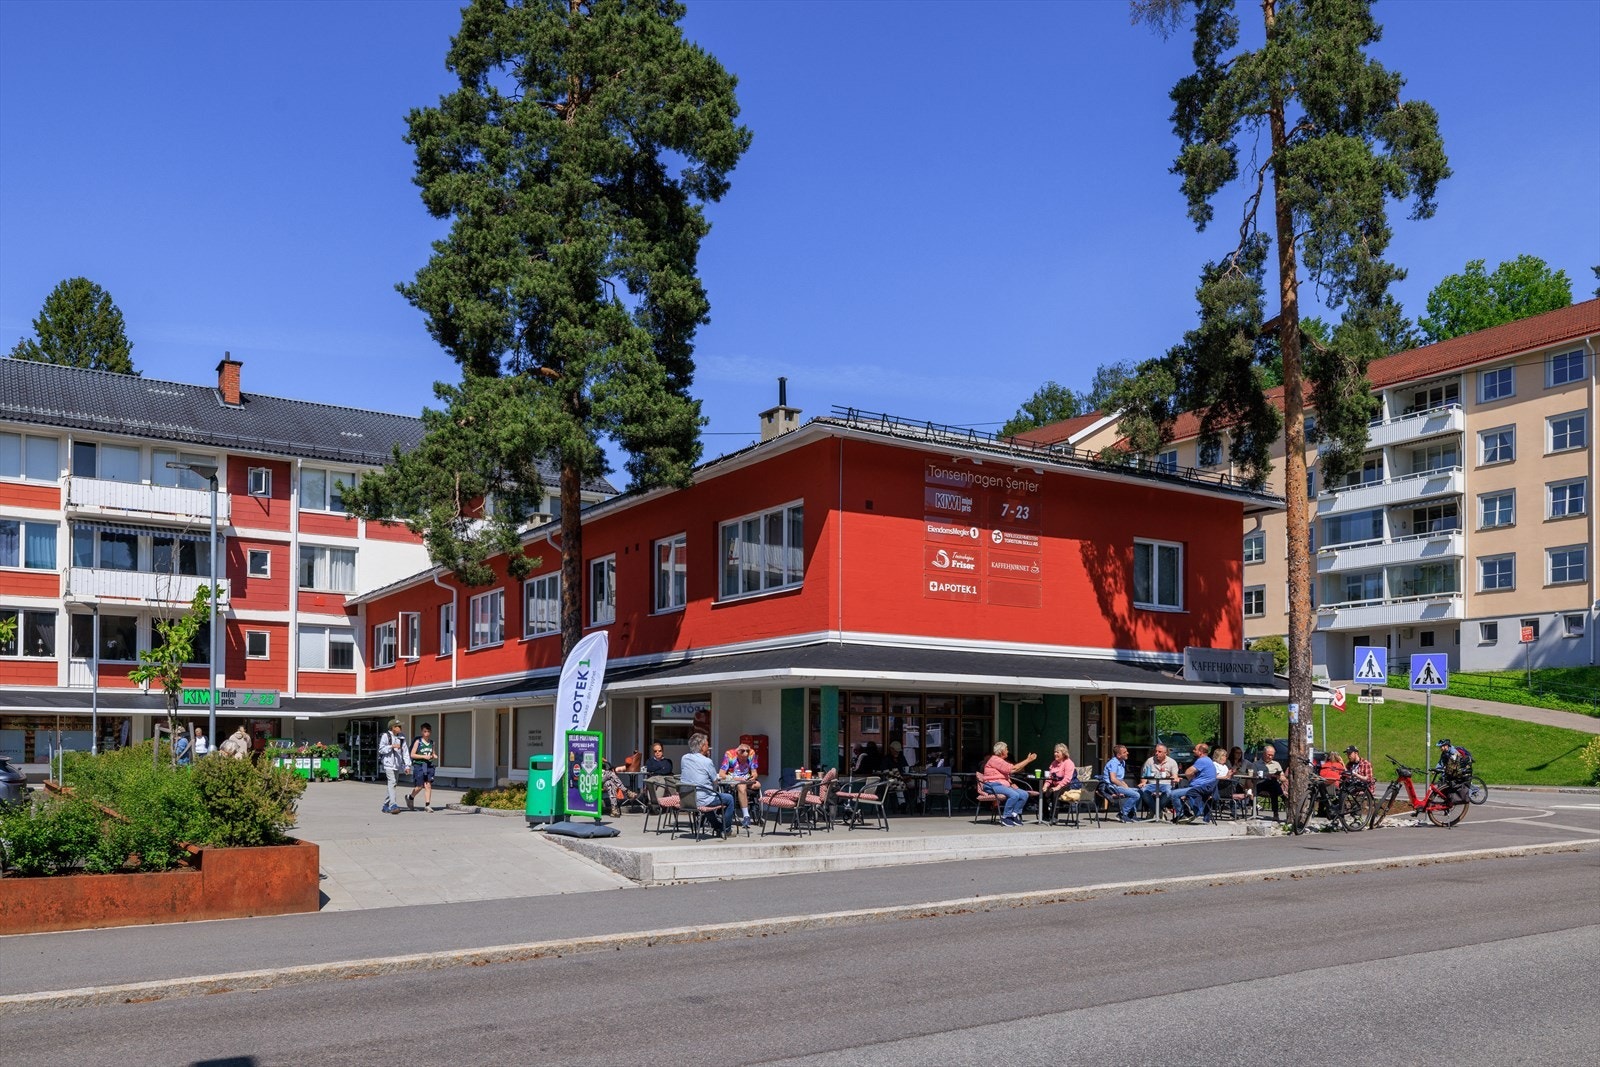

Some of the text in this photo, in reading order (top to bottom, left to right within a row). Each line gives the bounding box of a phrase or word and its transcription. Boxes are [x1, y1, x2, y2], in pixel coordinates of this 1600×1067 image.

[929, 465, 1039, 492] Tonsenhagen Senter
[935, 492, 962, 511] KIWI
[962, 505, 972, 513] pris
[1001, 504, 1009, 517] 7
[1016, 506, 1030, 520] 23
[939, 583, 971, 593] APOTEK
[579, 658, 590, 667] 1
[1192, 661, 1253, 674] KAFFEHJØRNET
[184, 689, 219, 705] KIWI
[221, 689, 236, 698] mini
[243, 693, 252, 704] 7
[259, 694, 274, 705] 23
[221, 698, 234, 706] pris
[580, 774, 591, 793] 89
